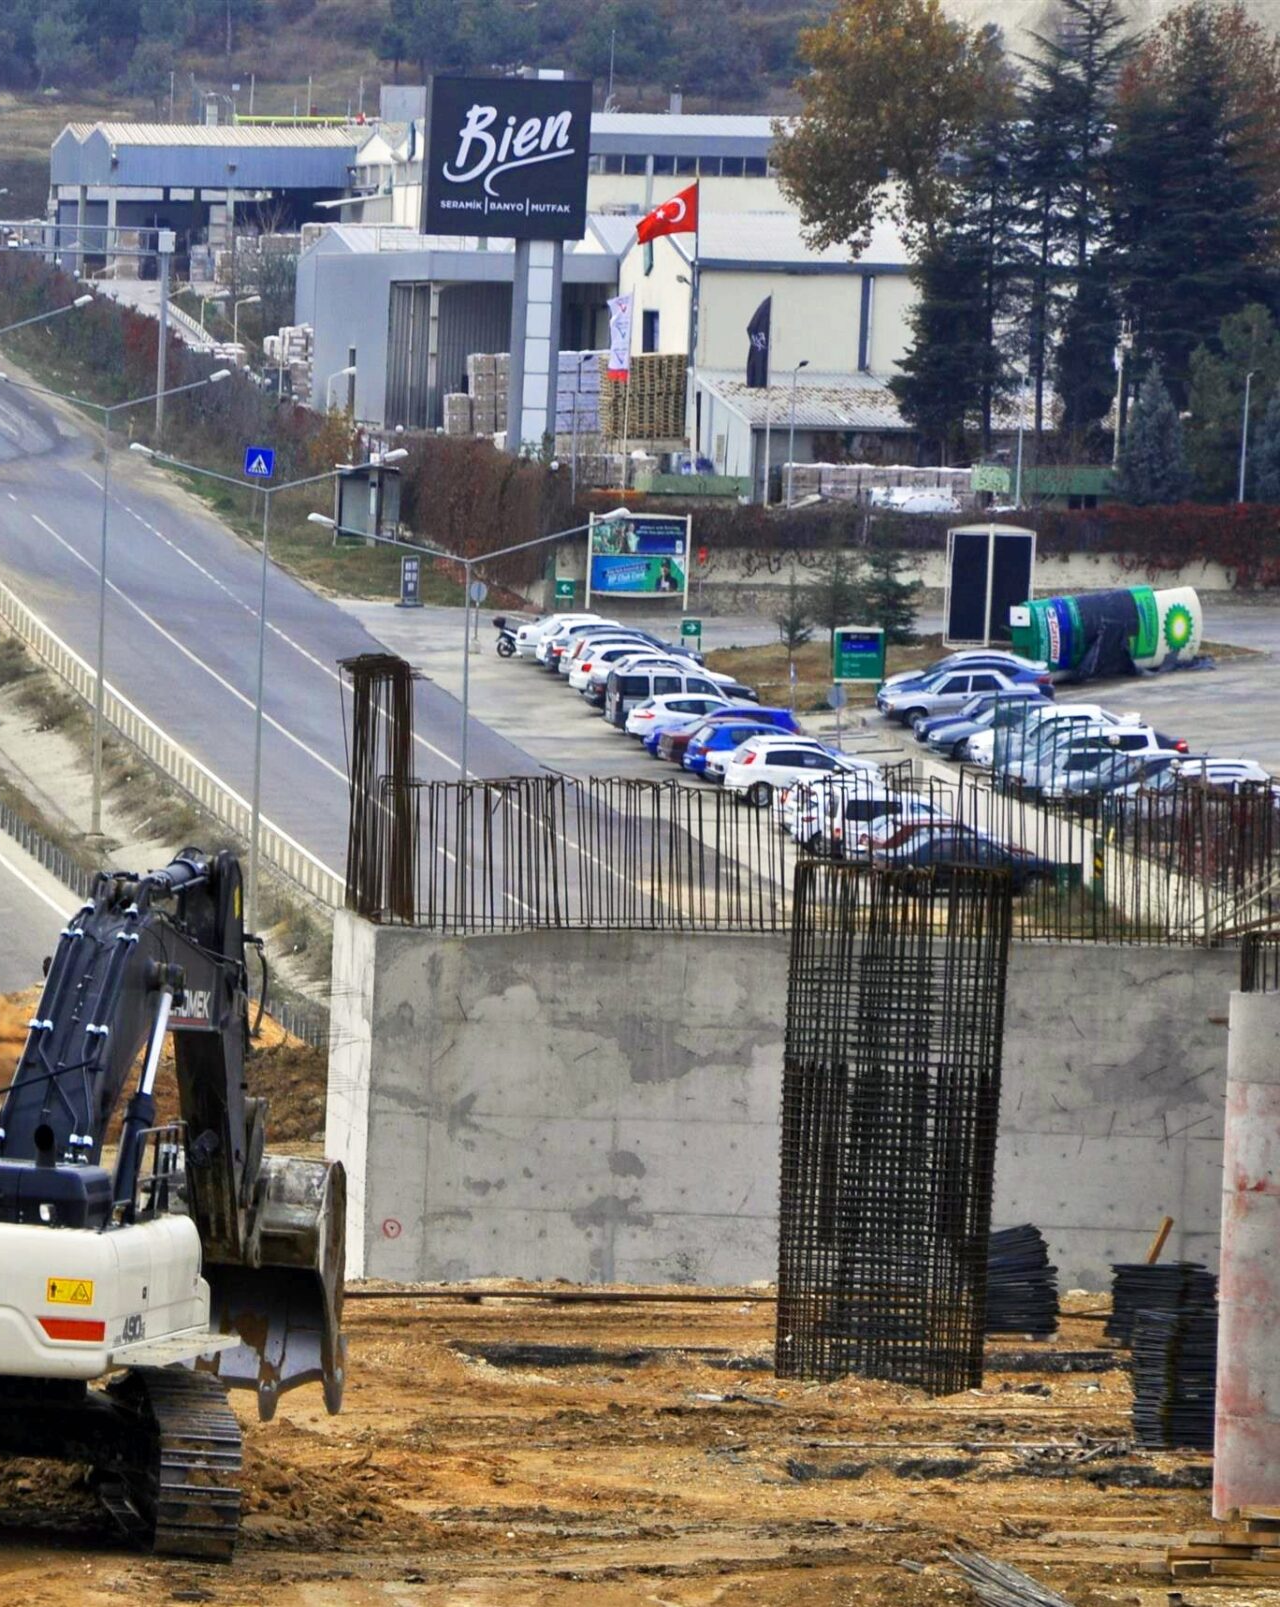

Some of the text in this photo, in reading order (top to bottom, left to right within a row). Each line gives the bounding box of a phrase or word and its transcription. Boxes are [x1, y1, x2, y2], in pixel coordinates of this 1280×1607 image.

[443, 104, 574, 187] Bien
[440, 199, 570, 213] SERAMİK BANYO MUTFAK
